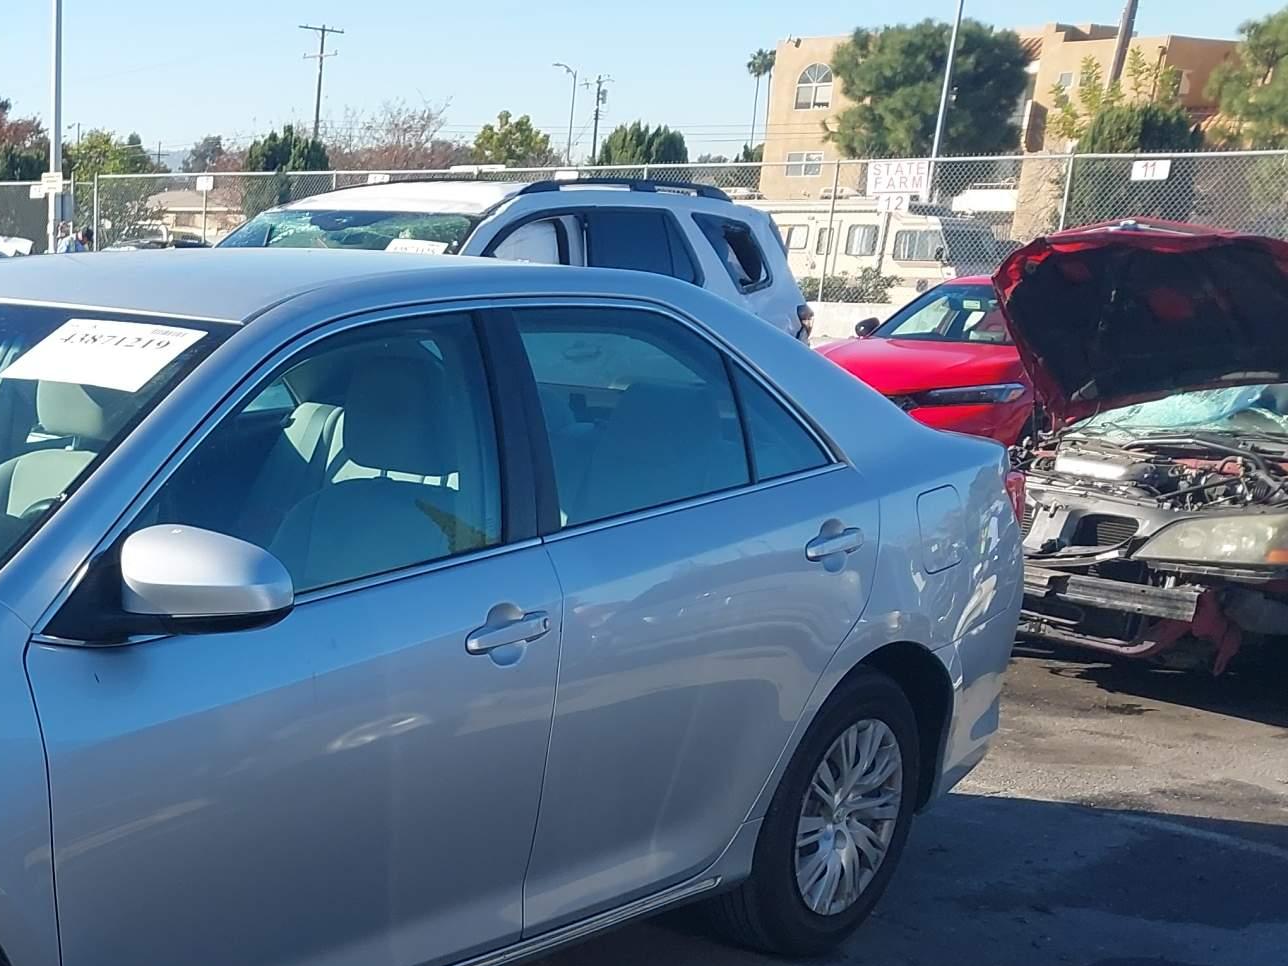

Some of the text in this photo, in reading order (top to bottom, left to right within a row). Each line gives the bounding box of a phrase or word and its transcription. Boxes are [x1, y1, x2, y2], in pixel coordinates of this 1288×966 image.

[872, 162, 927, 176] STATE
[873, 175, 923, 189] FARM
[881, 195, 904, 210] 12
[59, 332, 171, 349] 43871219
